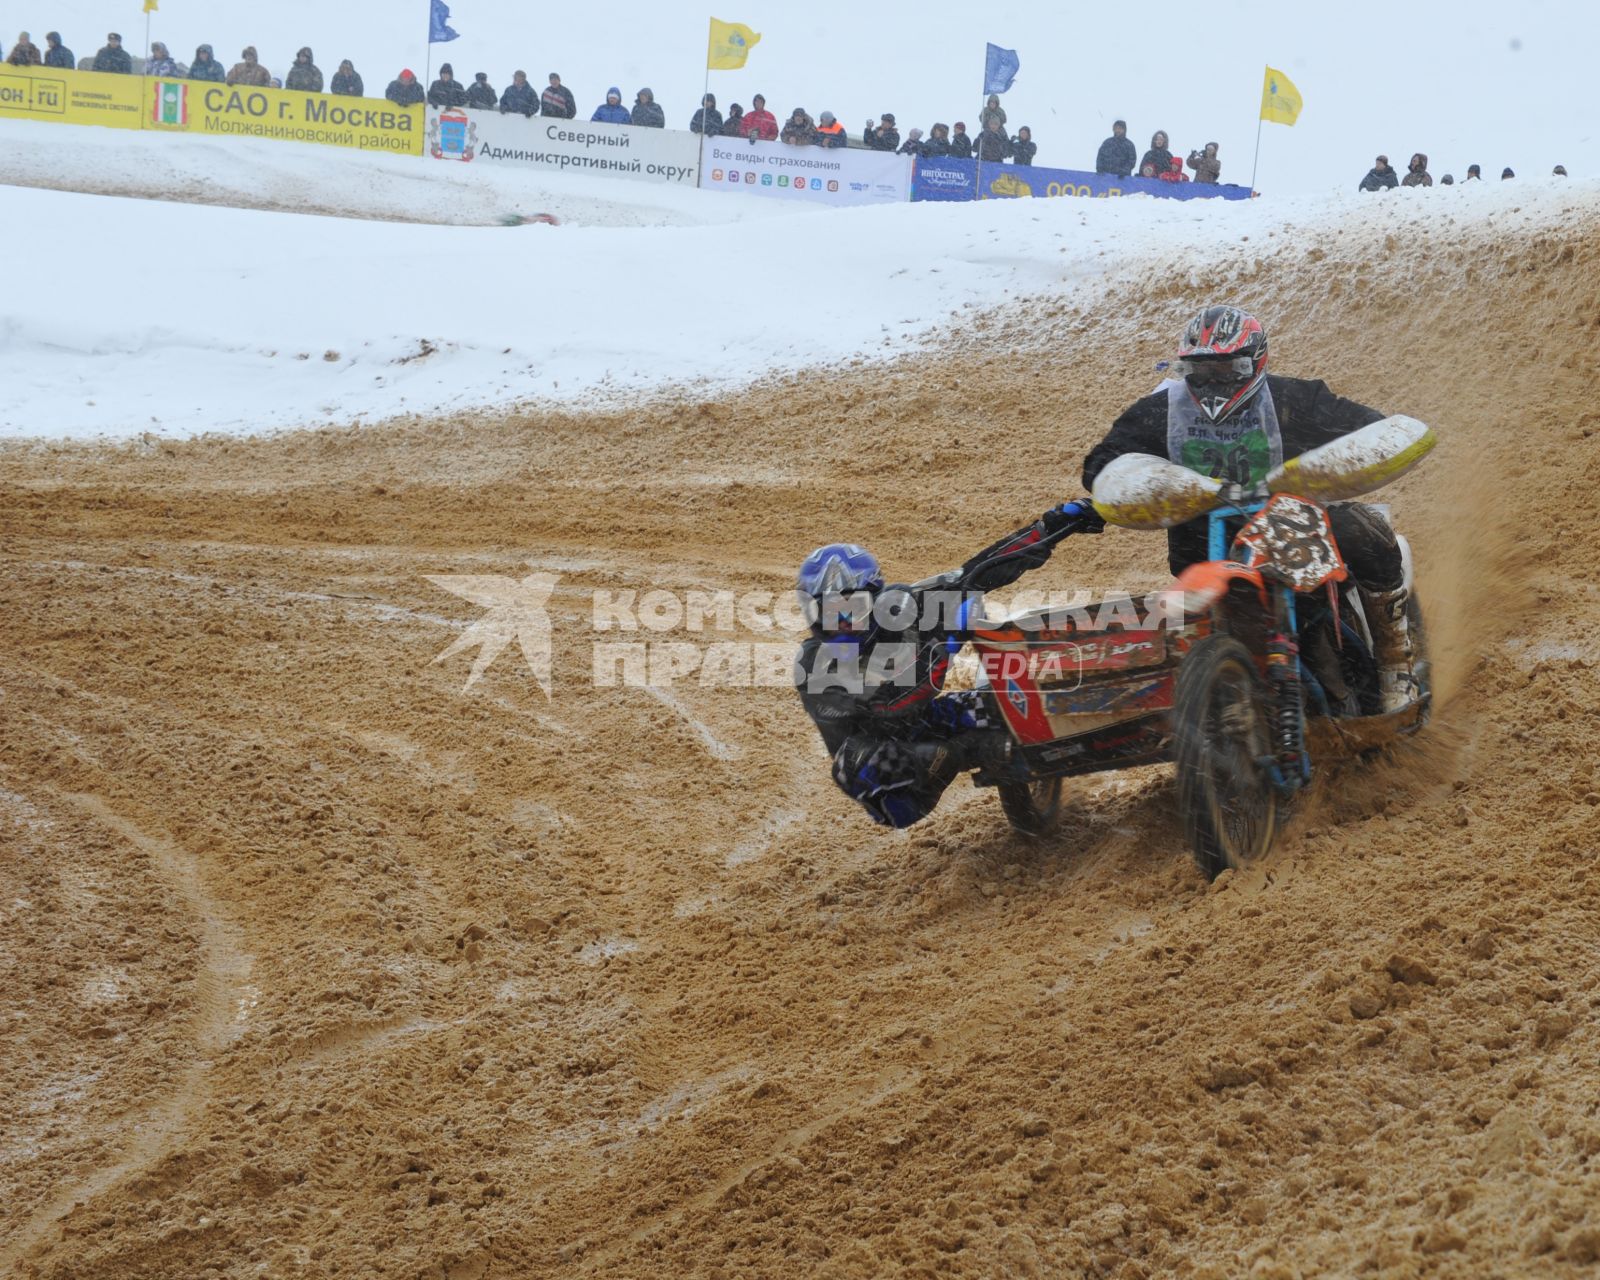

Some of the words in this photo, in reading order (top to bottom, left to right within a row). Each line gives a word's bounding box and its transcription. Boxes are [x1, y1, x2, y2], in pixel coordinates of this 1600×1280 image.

[204, 88, 269, 116] САО
[278, 101, 294, 120] г.
[304, 98, 413, 131] Москва
[204, 115, 354, 145] Молжаниновский
[359, 133, 411, 150] район
[546, 125, 630, 148] Северный
[479, 142, 641, 173] Административный
[646, 163, 695, 181] округ
[712, 149, 733, 160] Все
[735, 152, 765, 164] виды
[768, 157, 841, 171] страхования
[1202, 444, 1251, 487] 26
